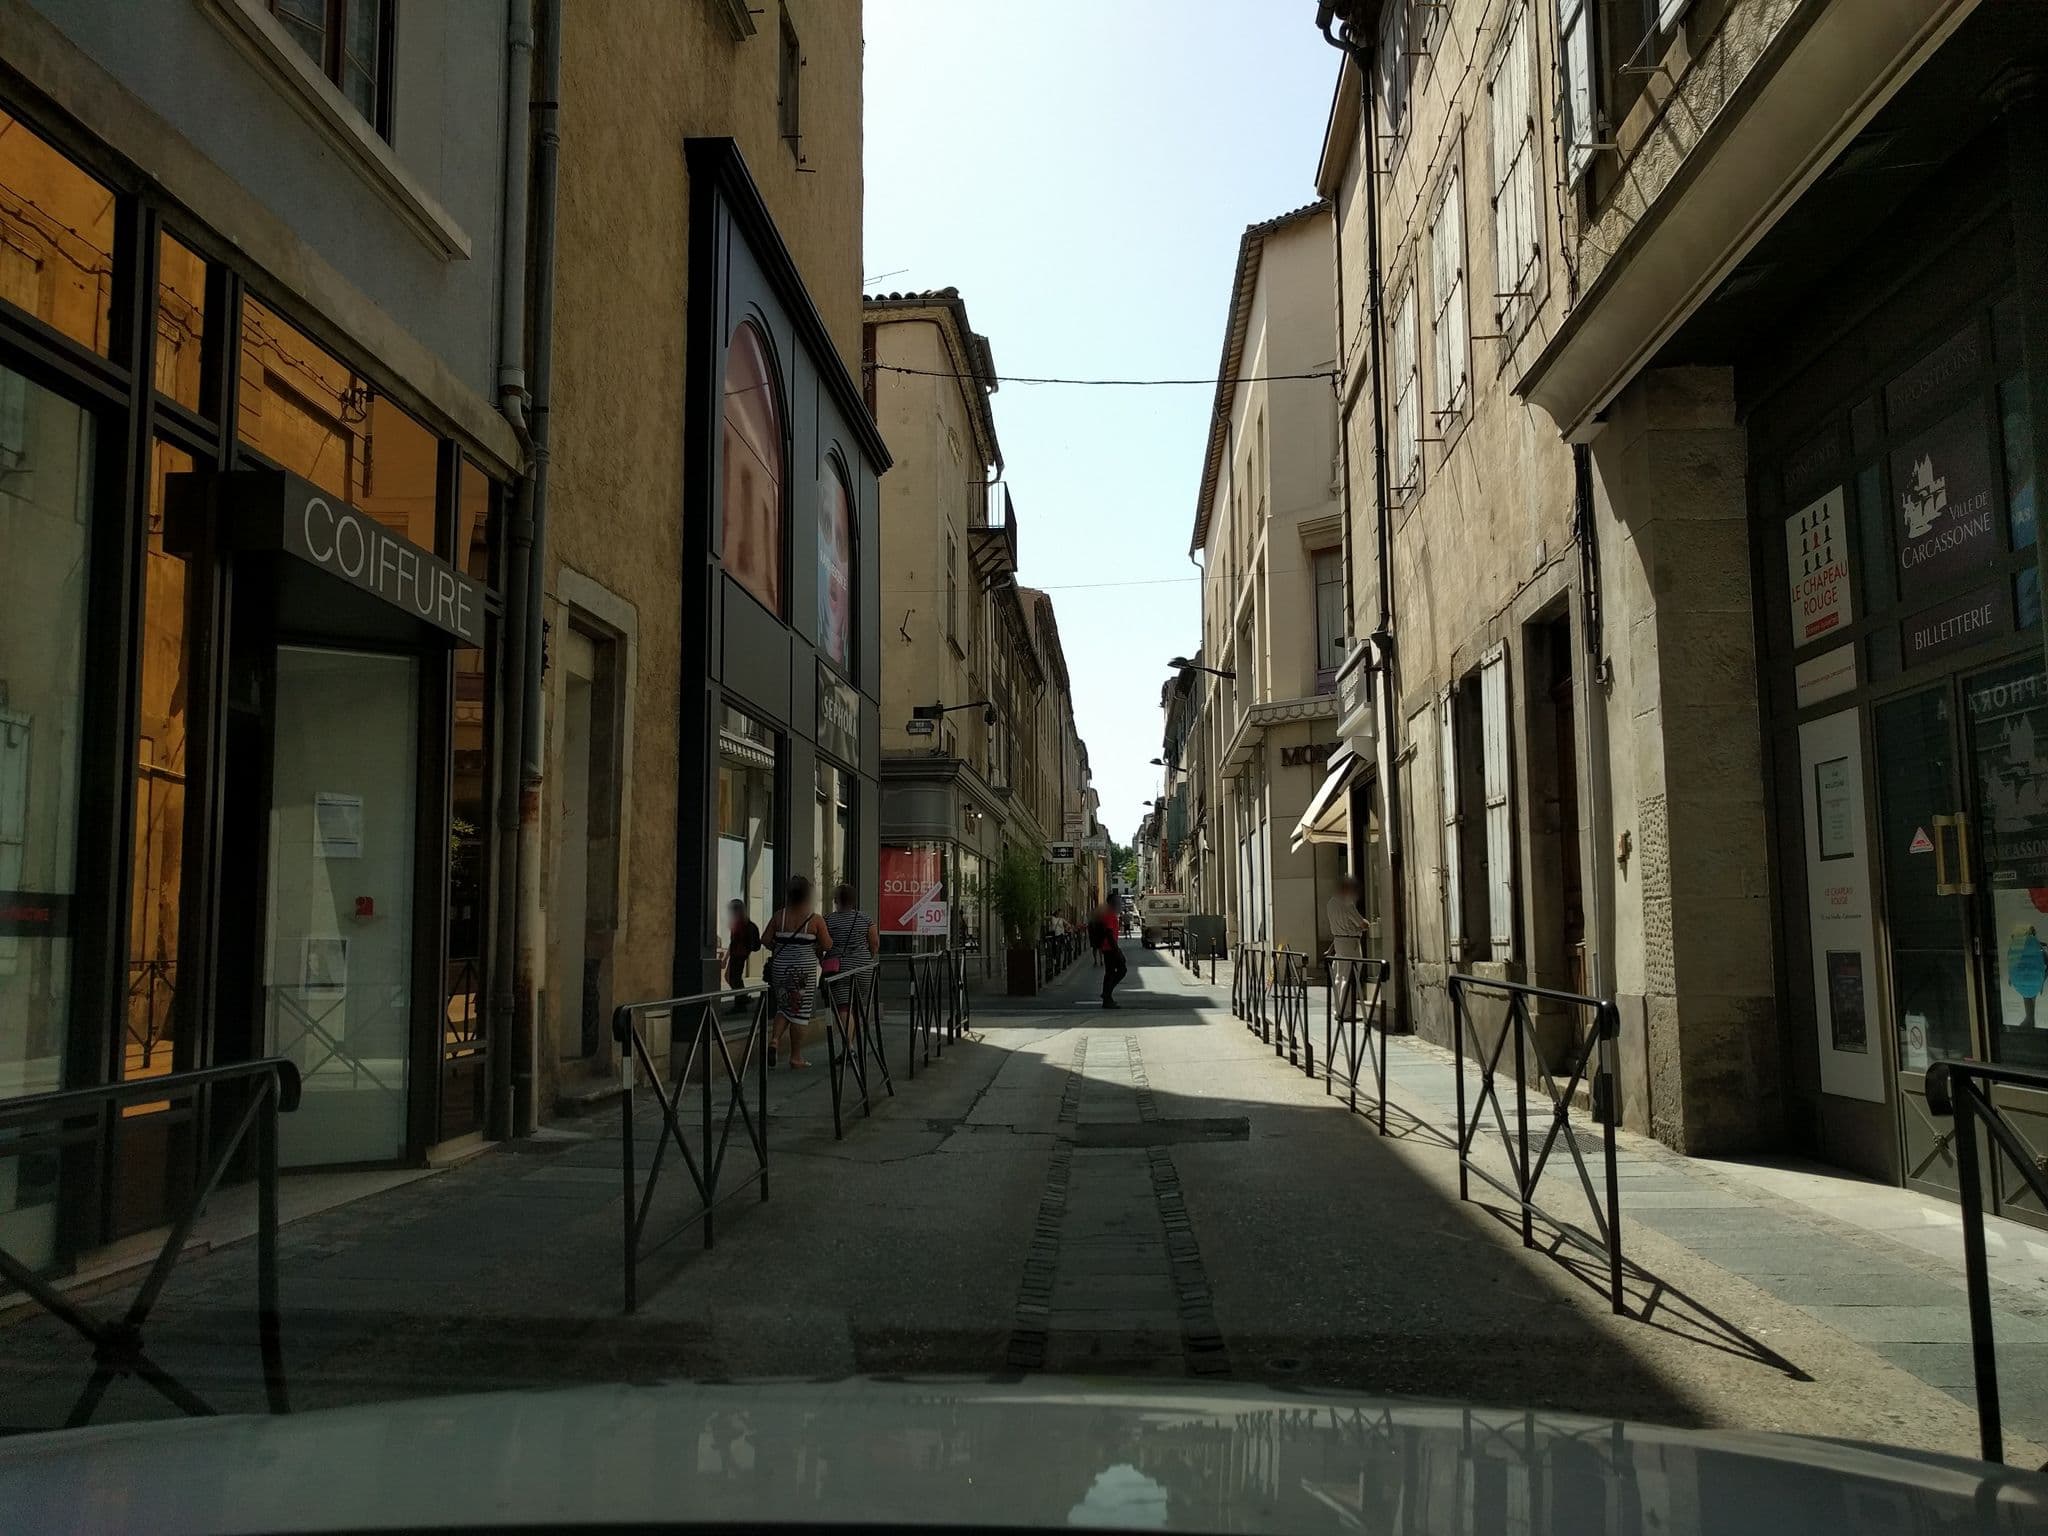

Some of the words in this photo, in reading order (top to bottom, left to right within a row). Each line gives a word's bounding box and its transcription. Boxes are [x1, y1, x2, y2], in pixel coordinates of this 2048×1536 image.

[1948, 497, 1973, 520] VILLE
[1975, 490, 1989, 509] DE
[1901, 512, 1992, 569] CARCASSONNE
[304, 497, 473, 637] COIFFURE
[1792, 584, 1801, 602] LE
[1803, 561, 1848, 596] CHAPEAU
[1804, 587, 1839, 616] ROUGE
[1914, 603, 1993, 650] BILLETTERIE
[823, 695, 857, 740] SEPHORA
